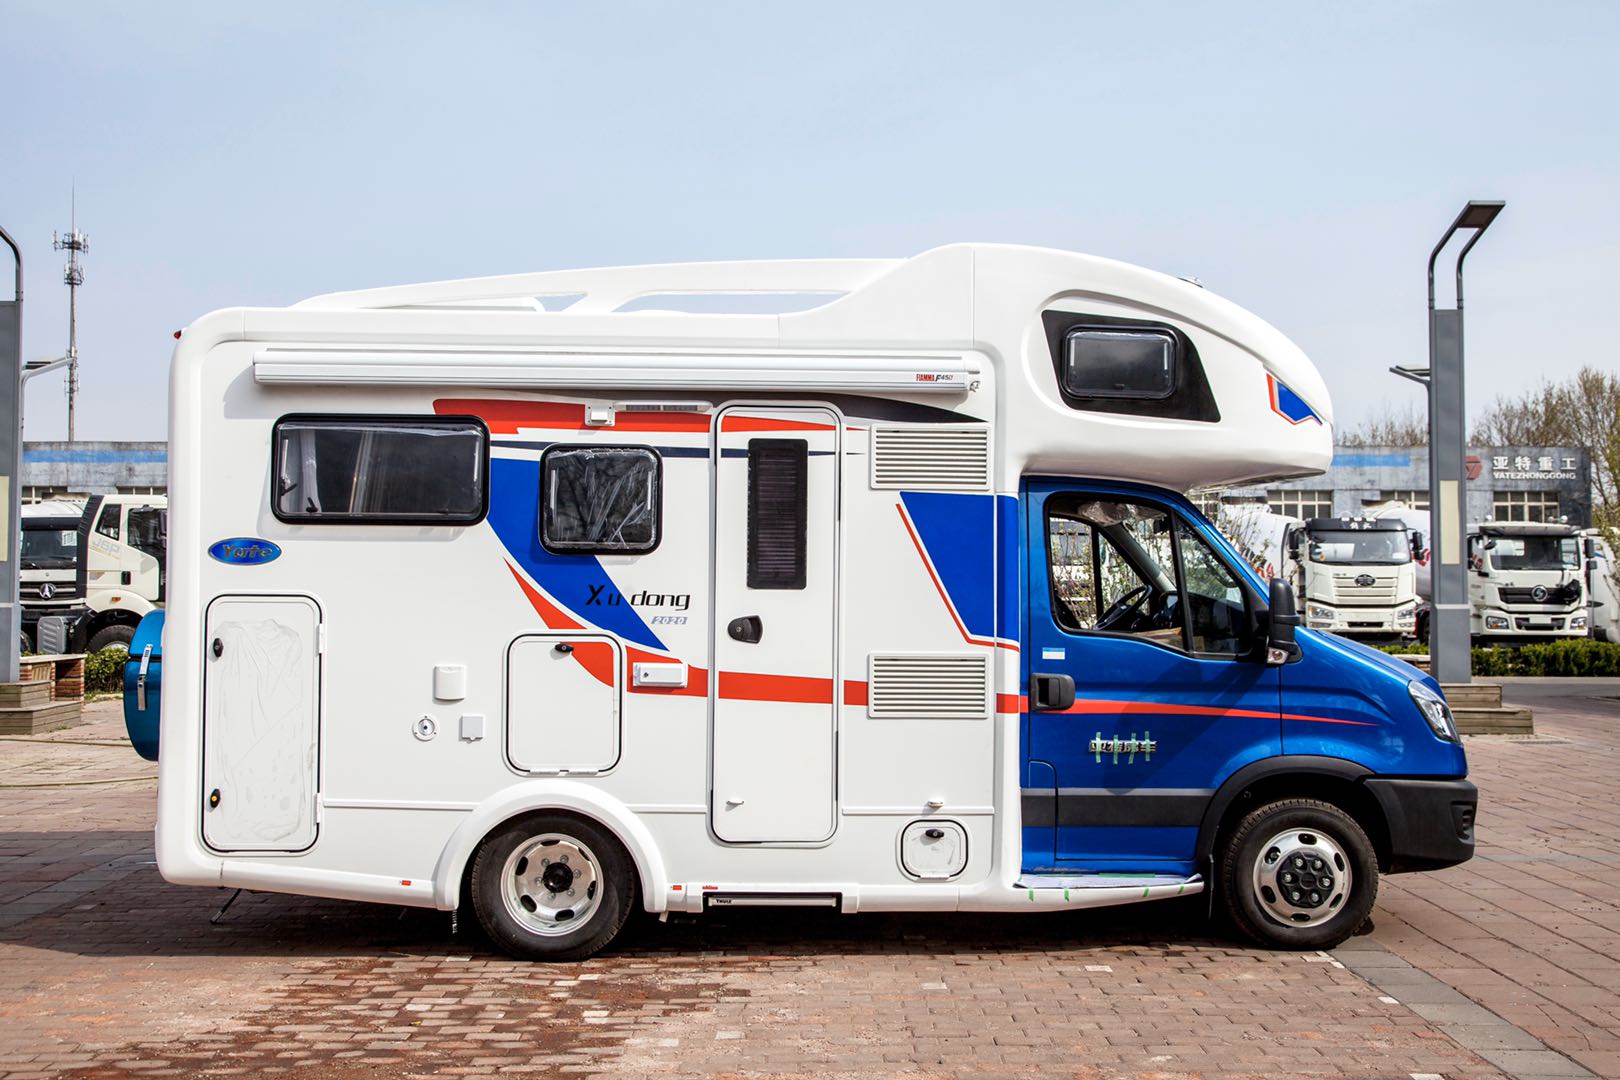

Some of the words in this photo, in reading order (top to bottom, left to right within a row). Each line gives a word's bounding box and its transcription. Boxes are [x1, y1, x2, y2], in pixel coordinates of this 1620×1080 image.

[1492, 456, 1577, 471] 亚特重工
[1493, 472, 1577, 480] YATEZHONGGONG
[222, 544, 273, 558] Yate
[630, 590, 691, 611] dong
[651, 616, 687, 625] 2020
